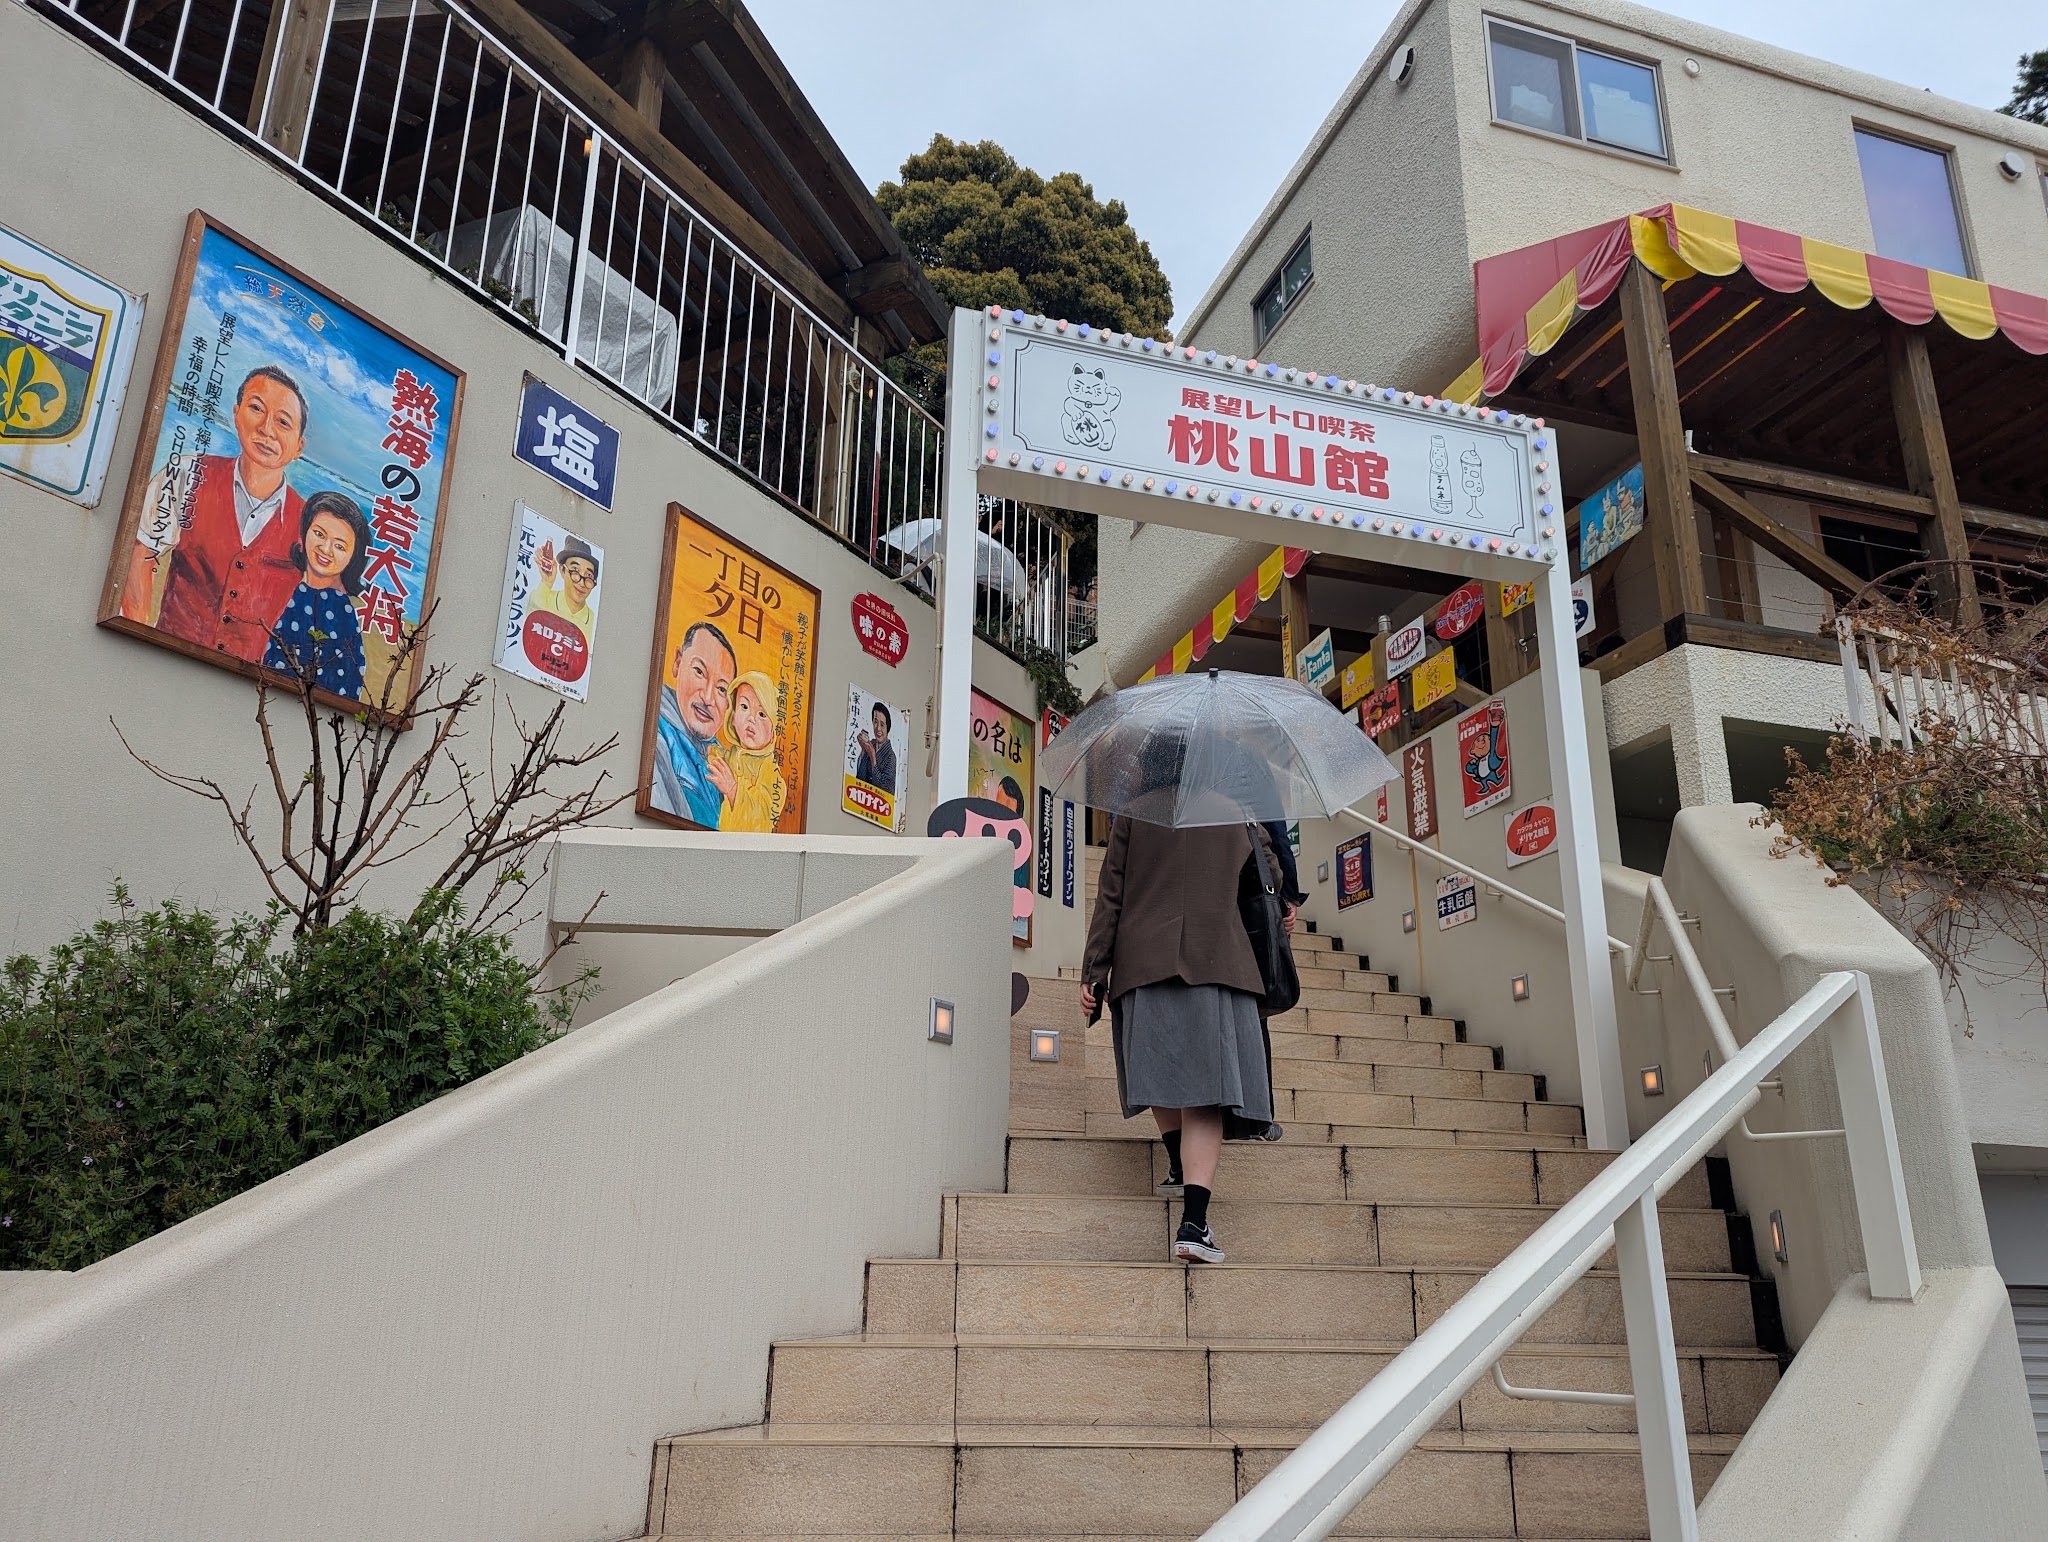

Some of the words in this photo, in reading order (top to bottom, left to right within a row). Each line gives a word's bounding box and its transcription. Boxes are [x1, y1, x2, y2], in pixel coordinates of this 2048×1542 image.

[0, 300, 93, 349] タンプ
[177, 335, 208, 417] 幸福の時間
[1181, 387, 1376, 444] 展望レトロ喫茶
[533, 406, 600, 491] 塩
[1167, 414, 1390, 500] 桃山館
[355, 368, 440, 645] 熱海の若大将
[1436, 475, 1446, 500] ラムネ
[689, 543, 782, 609] 一丁目の
[531, 622, 584, 653] オロナミン
[704, 581, 764, 644] 夕日
[859, 614, 901, 656] 味の素
[550, 643, 563, 657] C
[1306, 650, 1331, 682] Fanta
[1388, 628, 1419, 660] TANSAN
[1416, 654, 1451, 680] オリエンタル
[1426, 682, 1453, 703] カレー
[847, 691, 861, 769] 家中みんなで
[970, 711, 1022, 764] の名は
[1410, 746, 1430, 837] 火気厳禁
[1351, 888, 1372, 902] CURRY
